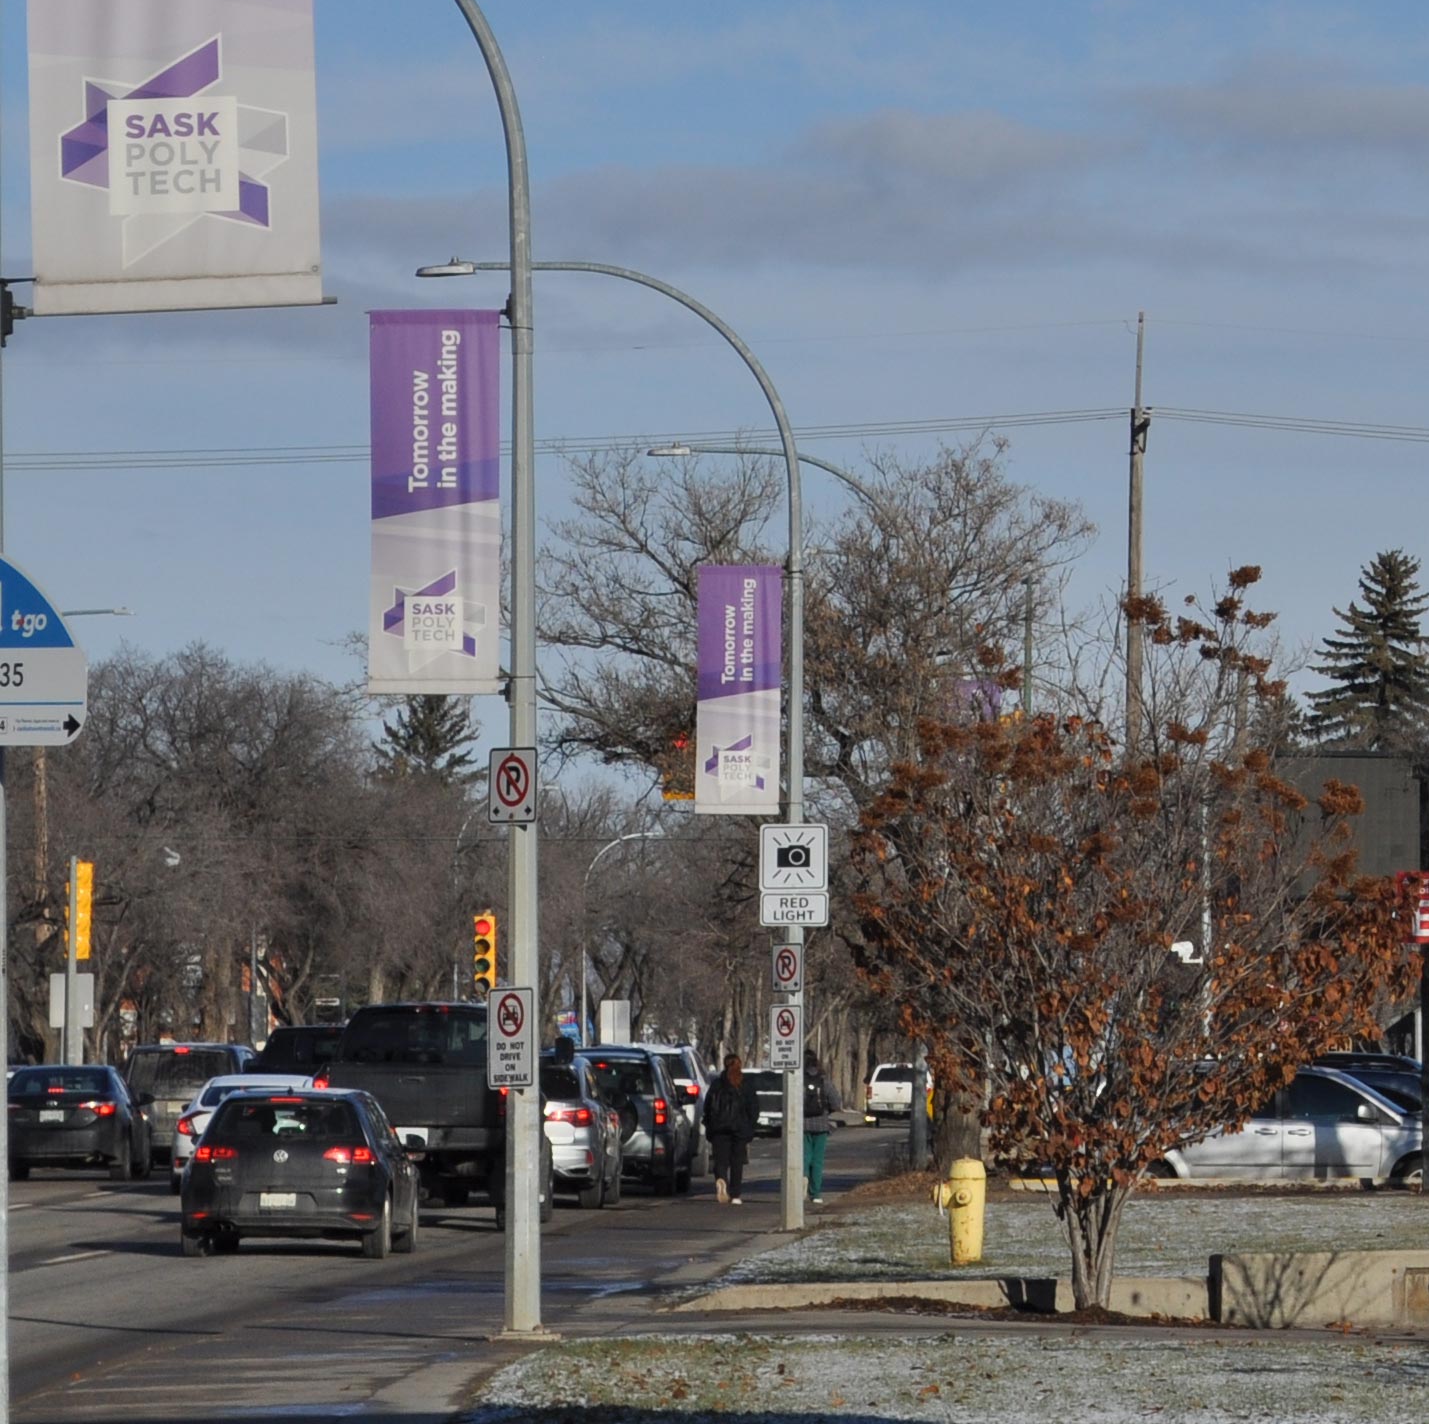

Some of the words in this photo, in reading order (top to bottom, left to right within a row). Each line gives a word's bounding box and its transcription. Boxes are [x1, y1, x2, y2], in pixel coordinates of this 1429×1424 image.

[125, 111, 220, 139] SASK
[126, 140, 220, 168] POLY
[125, 168, 221, 196] TECH
[437, 330, 461, 416] making
[408, 370, 429, 493] Tomorrow
[437, 422, 457, 461] the
[437, 466, 457, 488] in
[412, 603, 455, 615] SASK
[740, 578, 756, 635] making
[412, 616, 455, 628] POLY
[412, 629, 455, 641] TECH
[721, 604, 736, 685] Tomorrow
[740, 638, 753, 664] the
[740, 667, 753, 682] in
[723, 755, 752, 763] SASK
[780, 897, 809, 908] RED
[773, 910, 815, 921] LIGHT
[496, 1042, 506, 1051] DO
[510, 1042, 525, 1050] NOT
[500, 1053, 520, 1061] DRIVE
[493, 1073, 528, 1083] SIDEWALK
